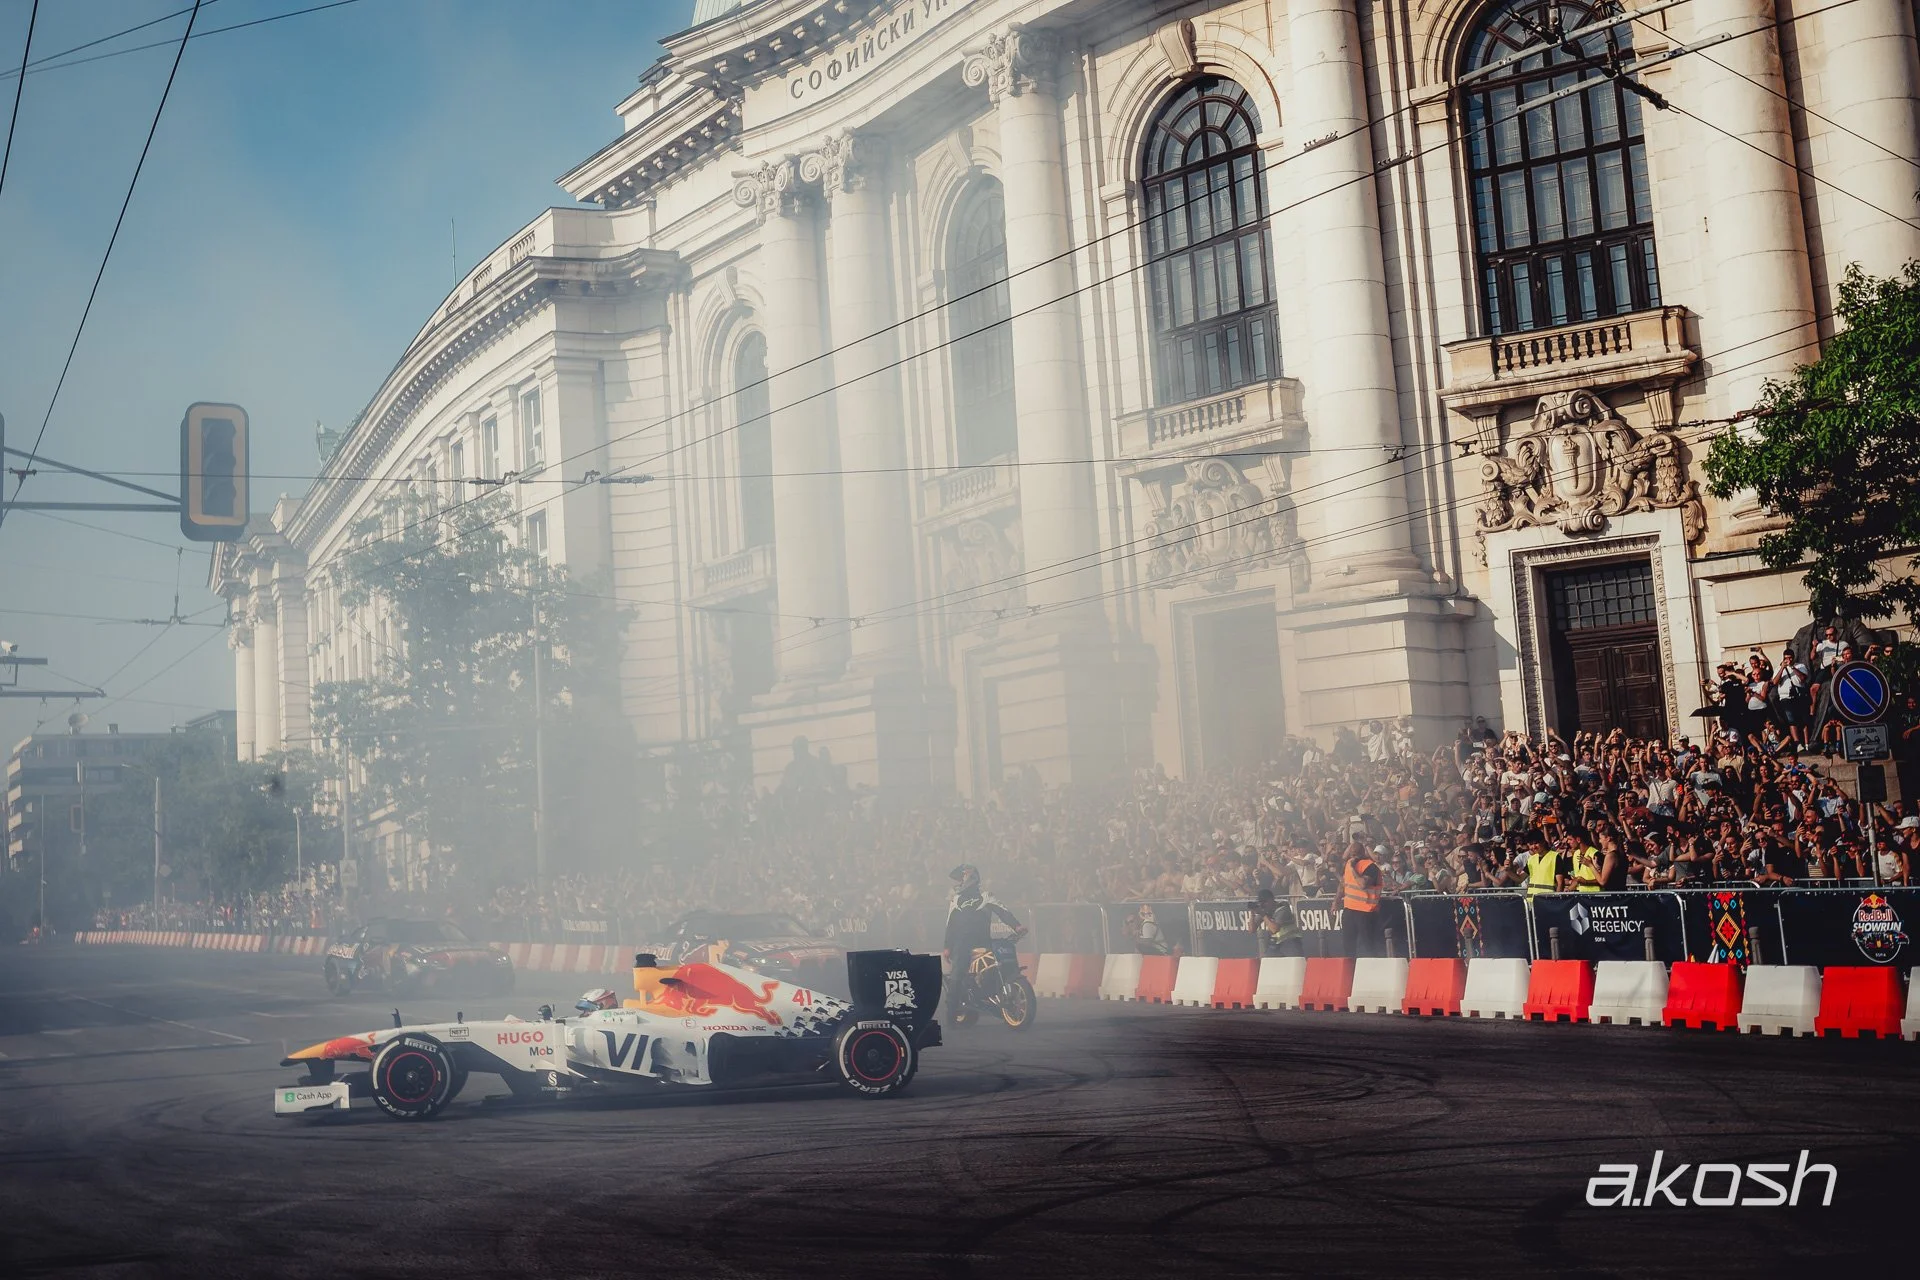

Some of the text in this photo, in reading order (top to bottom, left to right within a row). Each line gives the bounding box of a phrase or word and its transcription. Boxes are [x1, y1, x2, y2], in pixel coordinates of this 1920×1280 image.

[790, 8, 915, 99] СОФИЙСКИ
[1590, 906, 1628, 918] HYATT
[1196, 910, 1214, 931] RED
[1214, 910, 1239, 931] BULL
[1300, 909, 1332, 931] SOFIA
[1592, 920, 1642, 933] REGENCY
[1853, 921, 1902, 933] SHOWRUN
[885, 970, 909, 980] VISA
[792, 988, 812, 1007] 41
[497, 1030, 544, 1045] HUGO
[296, 1091, 332, 1101] Cash App
